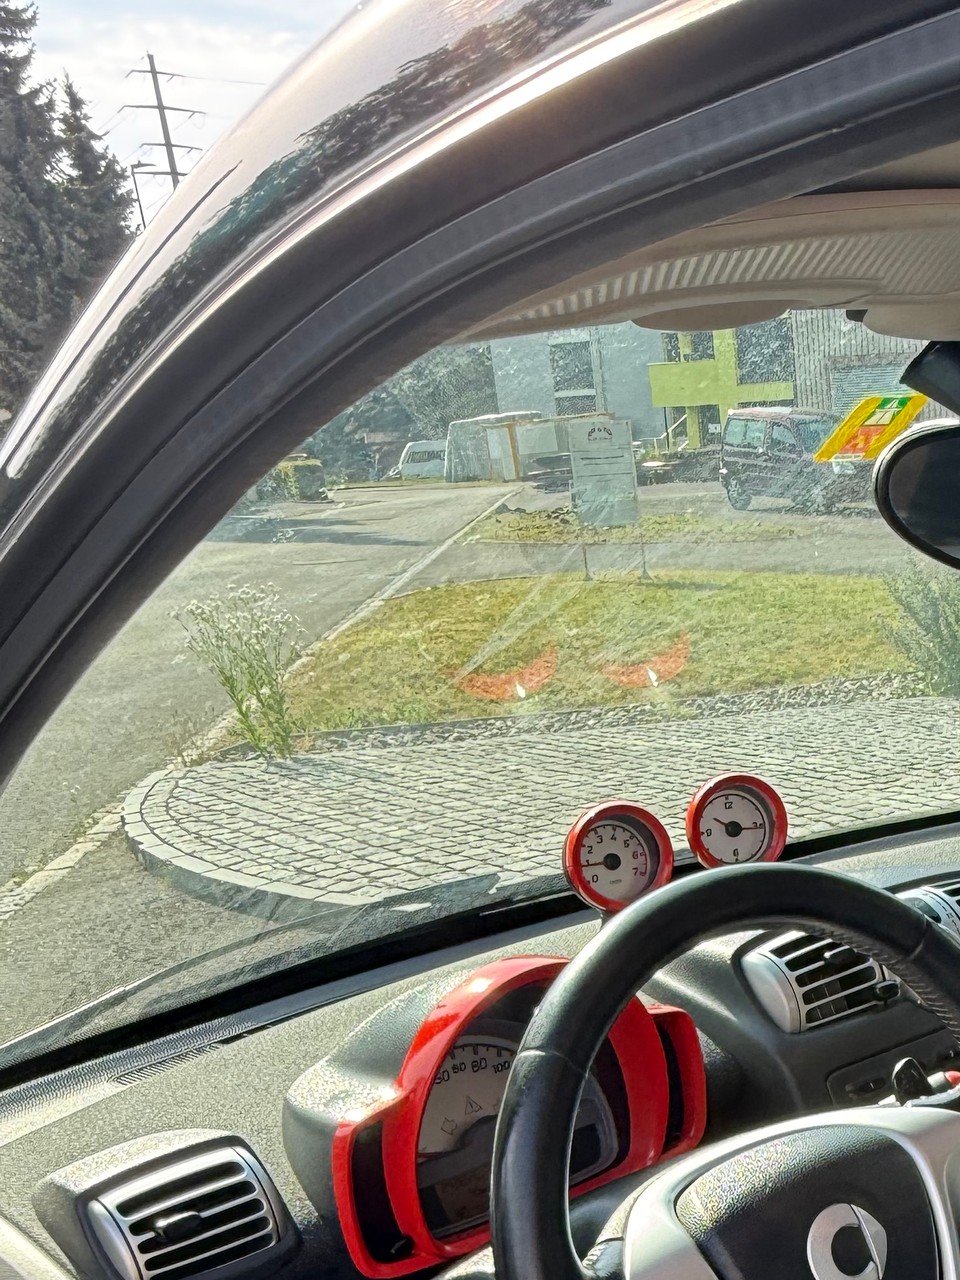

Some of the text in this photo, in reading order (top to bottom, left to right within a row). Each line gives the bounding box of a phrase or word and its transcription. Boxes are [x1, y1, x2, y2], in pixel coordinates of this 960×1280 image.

[596, 835, 603, 844] 3
[610, 833, 617, 842] 4
[587, 845, 594, 855] 2
[632, 851, 639, 860] 6
[632, 867, 638, 877] 7
[591, 874, 599, 883] 0
